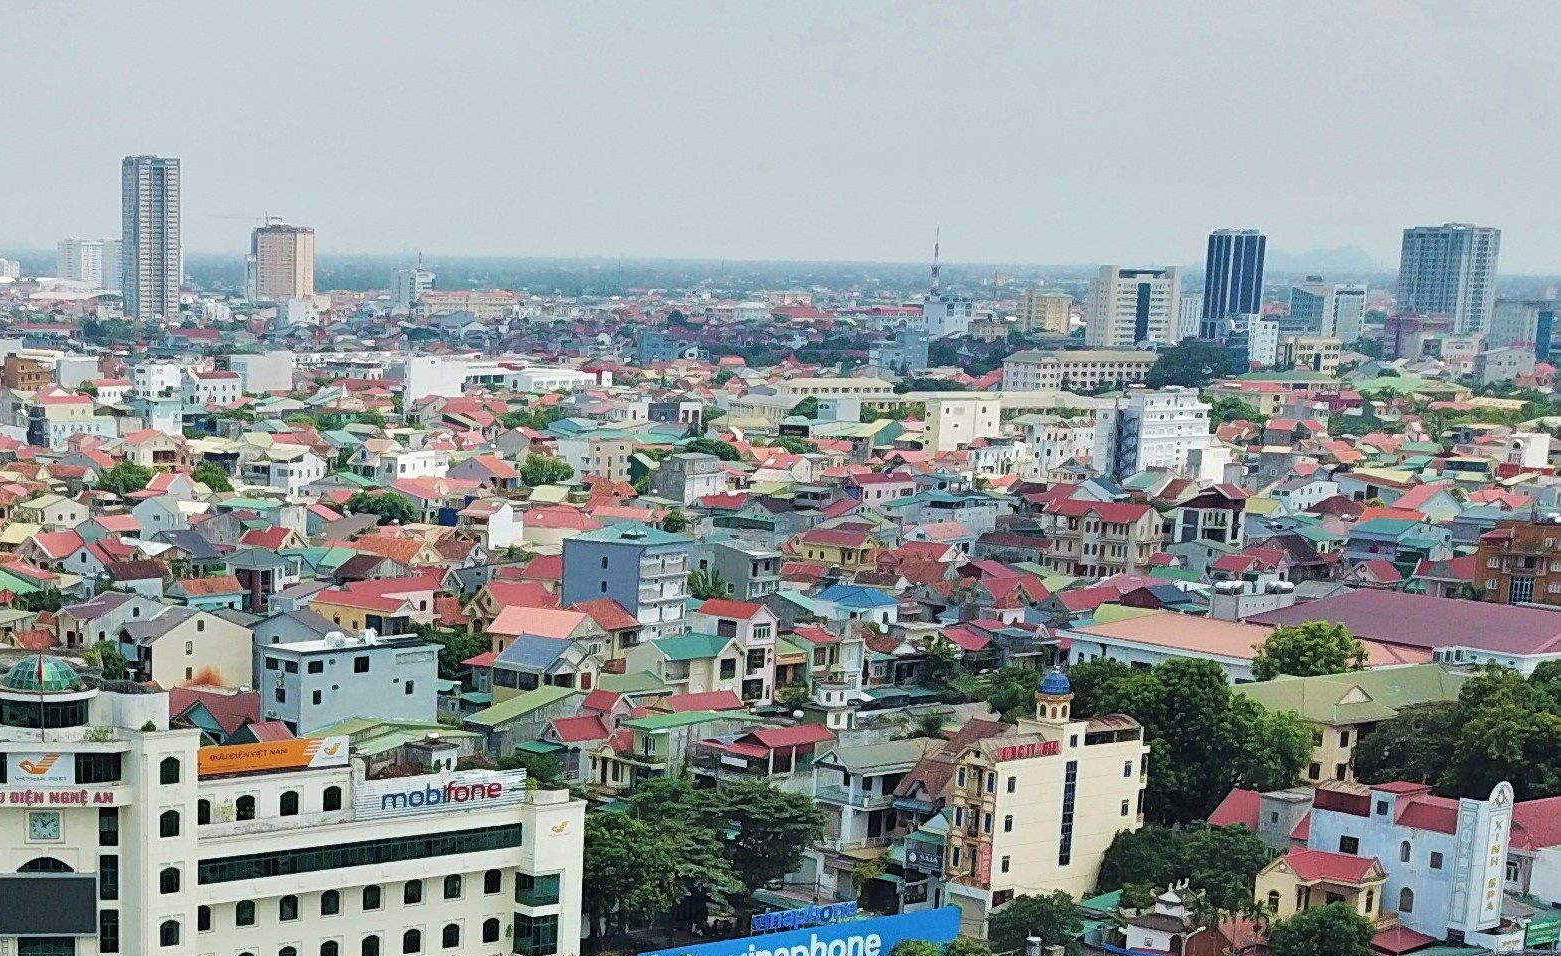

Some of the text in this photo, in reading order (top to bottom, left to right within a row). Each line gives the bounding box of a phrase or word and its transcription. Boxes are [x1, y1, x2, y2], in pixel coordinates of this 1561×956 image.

[9, 789, 44, 806] ĐIỆN
[49, 789, 89, 806] NGHỆ
[93, 791, 114, 804] AN
[381, 780, 503, 811] mobifone
[1486, 820, 1503, 911] XINH SPA
